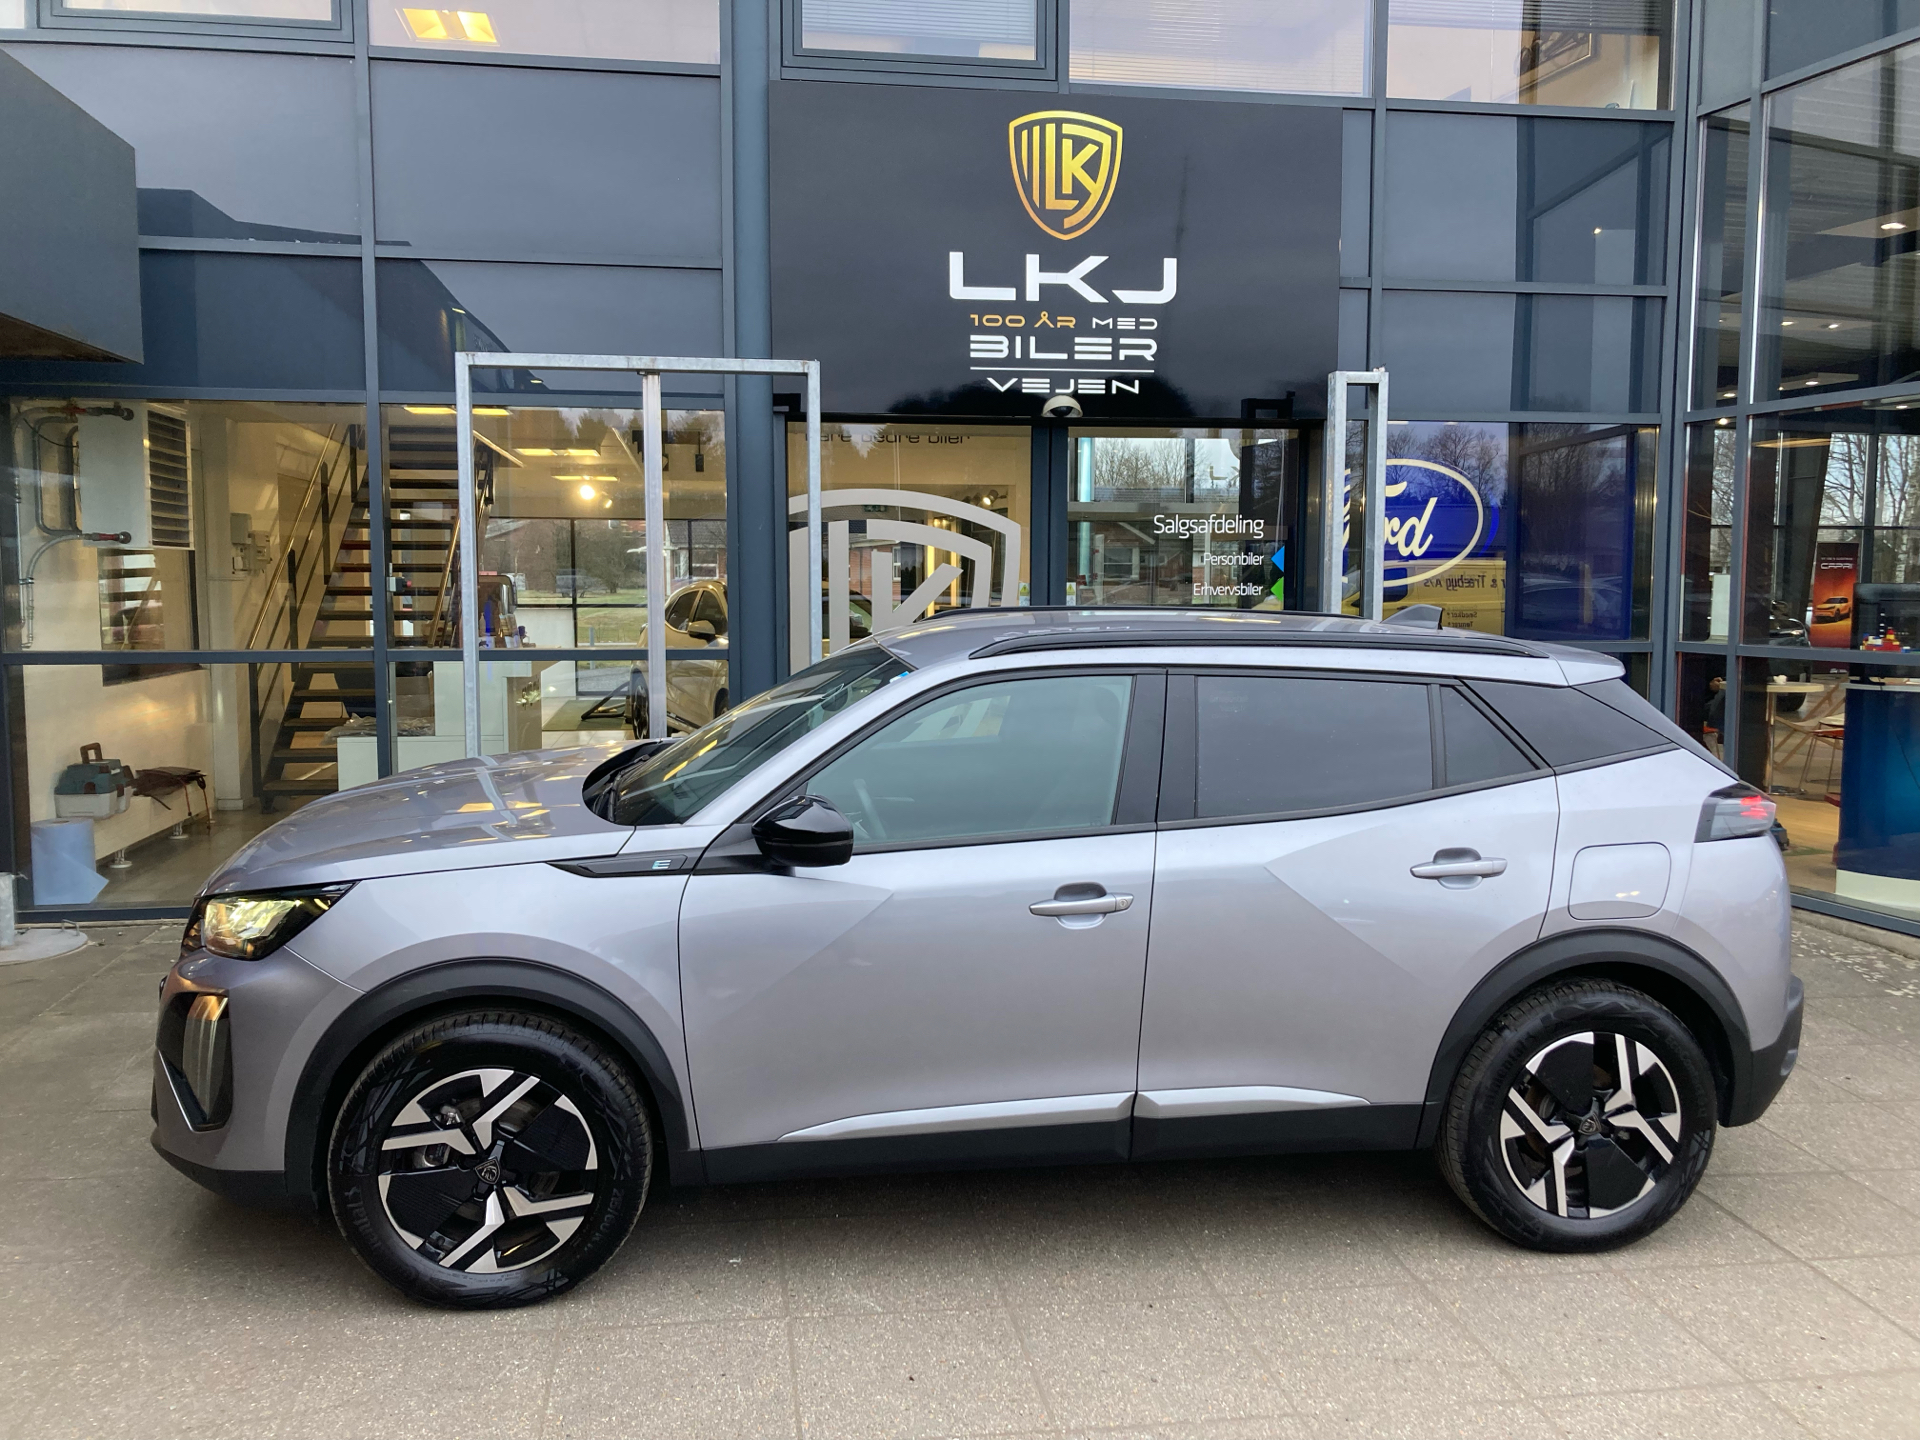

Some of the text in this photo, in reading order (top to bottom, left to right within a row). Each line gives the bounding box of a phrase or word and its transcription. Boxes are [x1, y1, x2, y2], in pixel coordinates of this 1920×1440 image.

[949, 250, 1178, 305] LKJ
[969, 310, 1159, 331] 100 ÅR MED
[969, 334, 1158, 362] BILER
[986, 376, 1140, 395] VEJEN
[1153, 513, 1265, 539] Salgsafdeling
[1203, 551, 1265, 566] Personbiler
[1193, 582, 1264, 596] Erhvervsbiler
